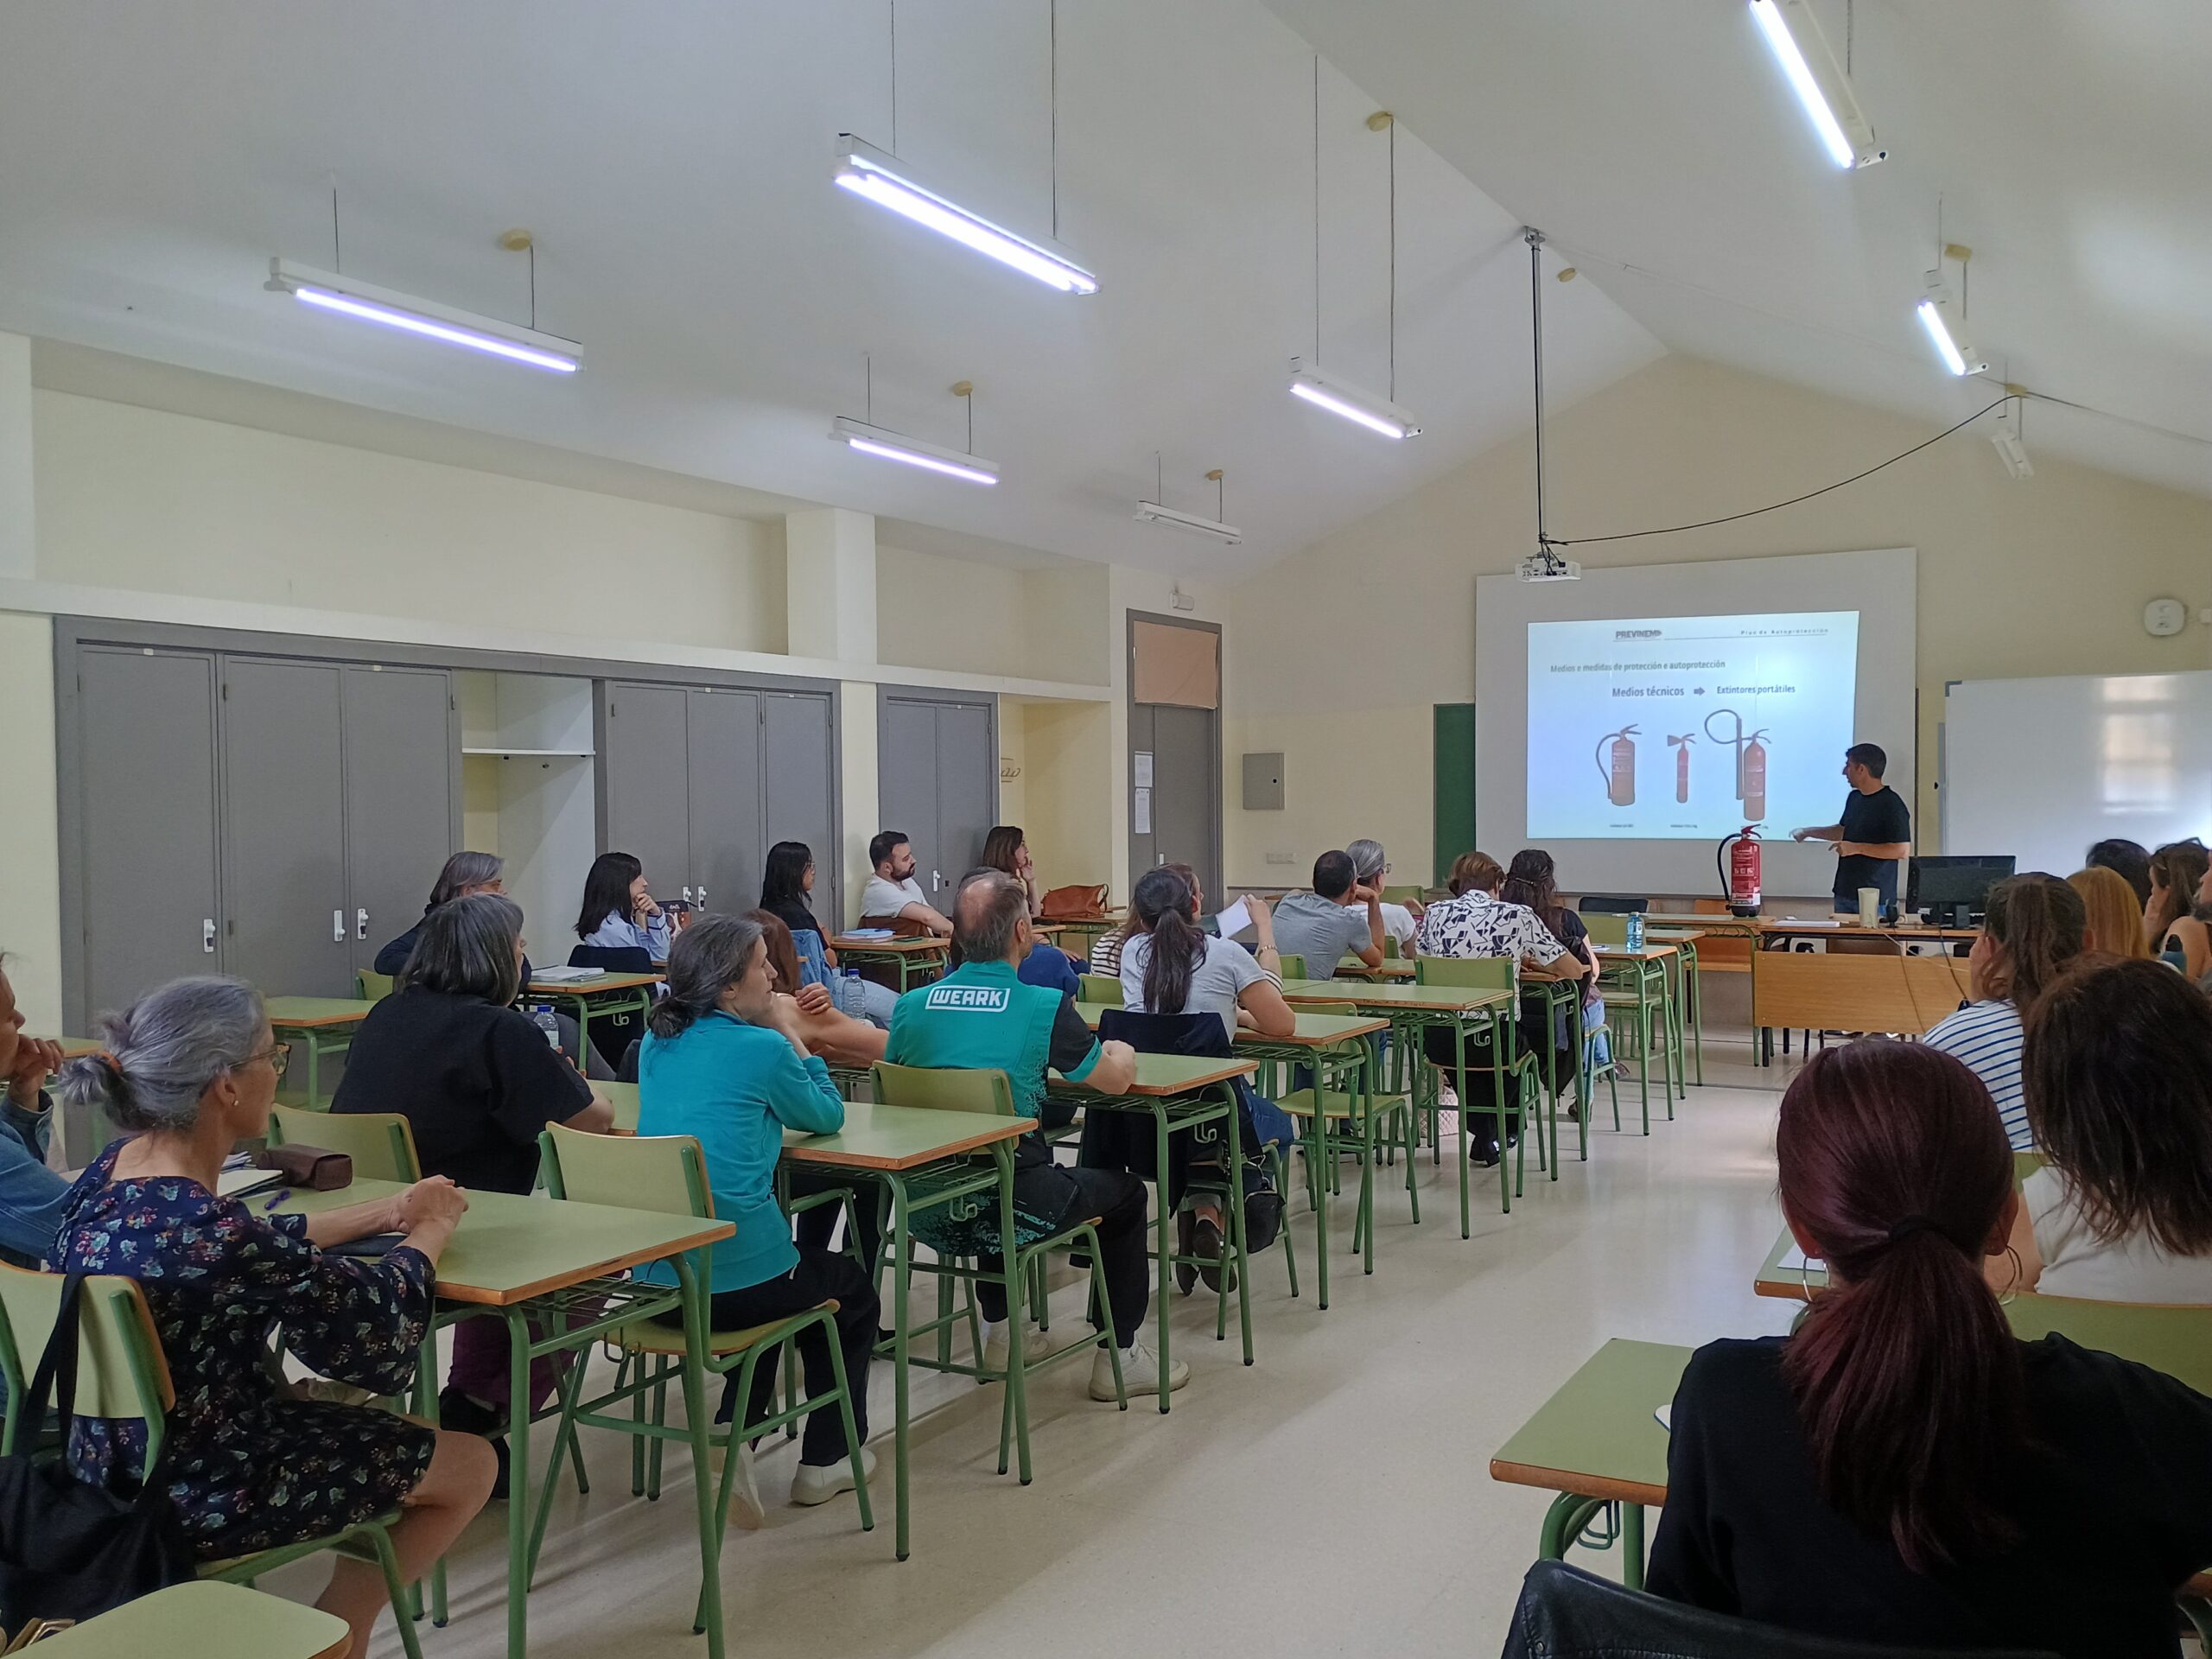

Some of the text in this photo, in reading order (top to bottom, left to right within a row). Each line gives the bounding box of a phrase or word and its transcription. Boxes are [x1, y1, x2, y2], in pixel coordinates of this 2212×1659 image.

[1550, 664, 1576, 672] Medios
[1583, 663, 1612, 671] medidas
[1613, 663, 1623, 671] de
[1624, 661, 1662, 672] protección
[1669, 659, 1726, 671] autoprotección
[1612, 685, 1685, 697] Medios técnicos
[1717, 684, 1796, 695] Extintores portátiles
[932, 989, 1002, 1006] WEARK
